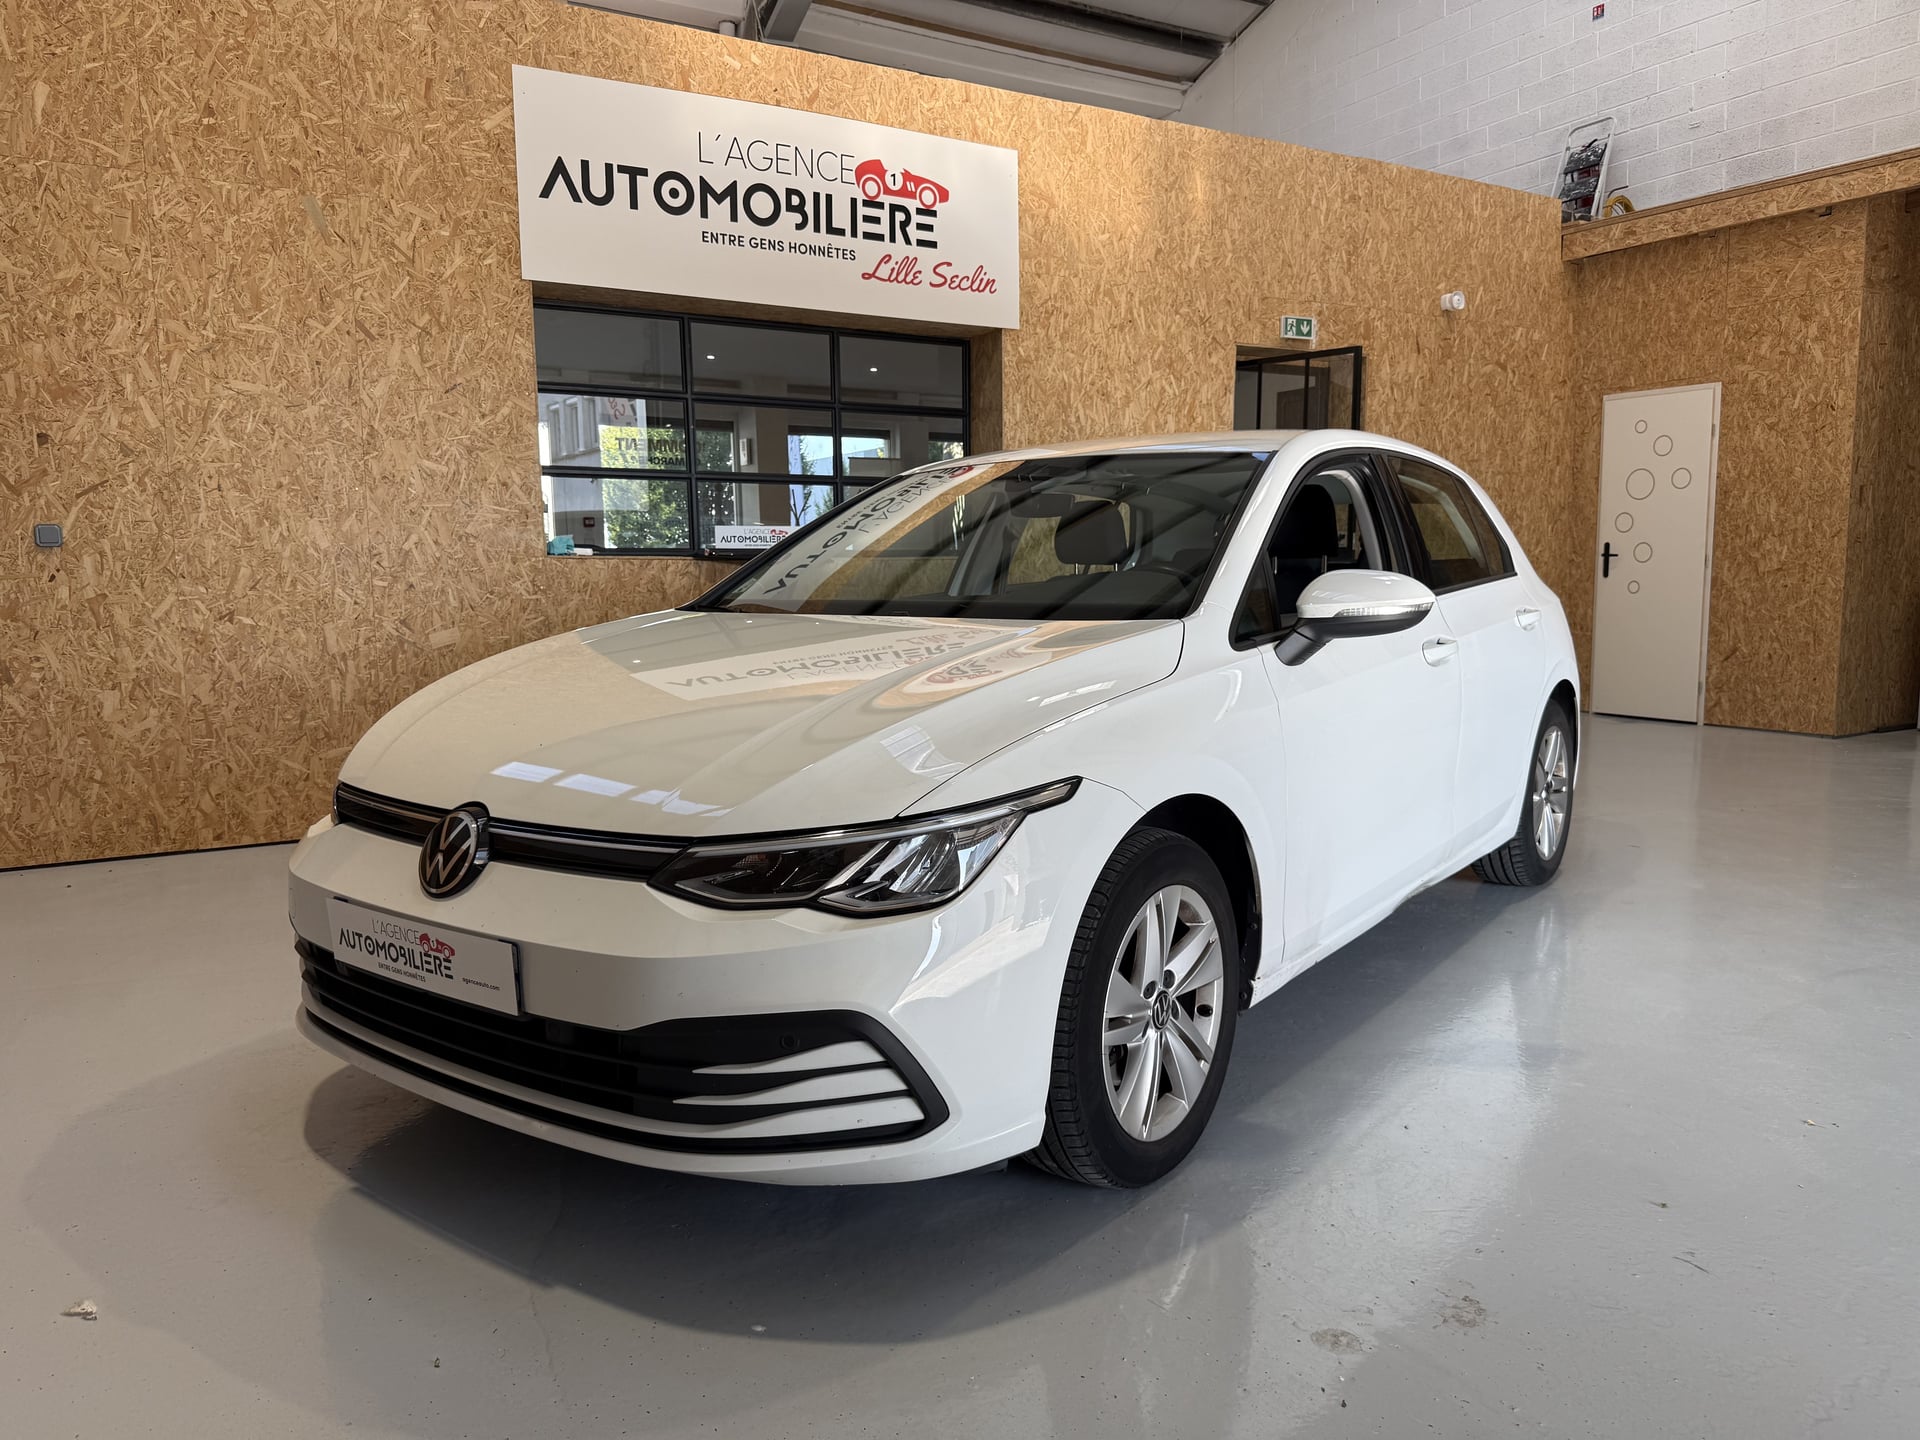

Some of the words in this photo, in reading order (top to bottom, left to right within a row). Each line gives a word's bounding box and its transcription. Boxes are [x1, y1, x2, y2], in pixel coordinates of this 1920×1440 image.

[698, 131, 856, 186] L'AGENCE
[701, 230, 745, 248] ENTRE
[748, 236, 785, 253] GENS
[788, 241, 857, 261] HONNÊTES
[861, 253, 923, 287] Lille
[929, 261, 998, 295] Seclin
[371, 918, 420, 946] L'AGENCE
